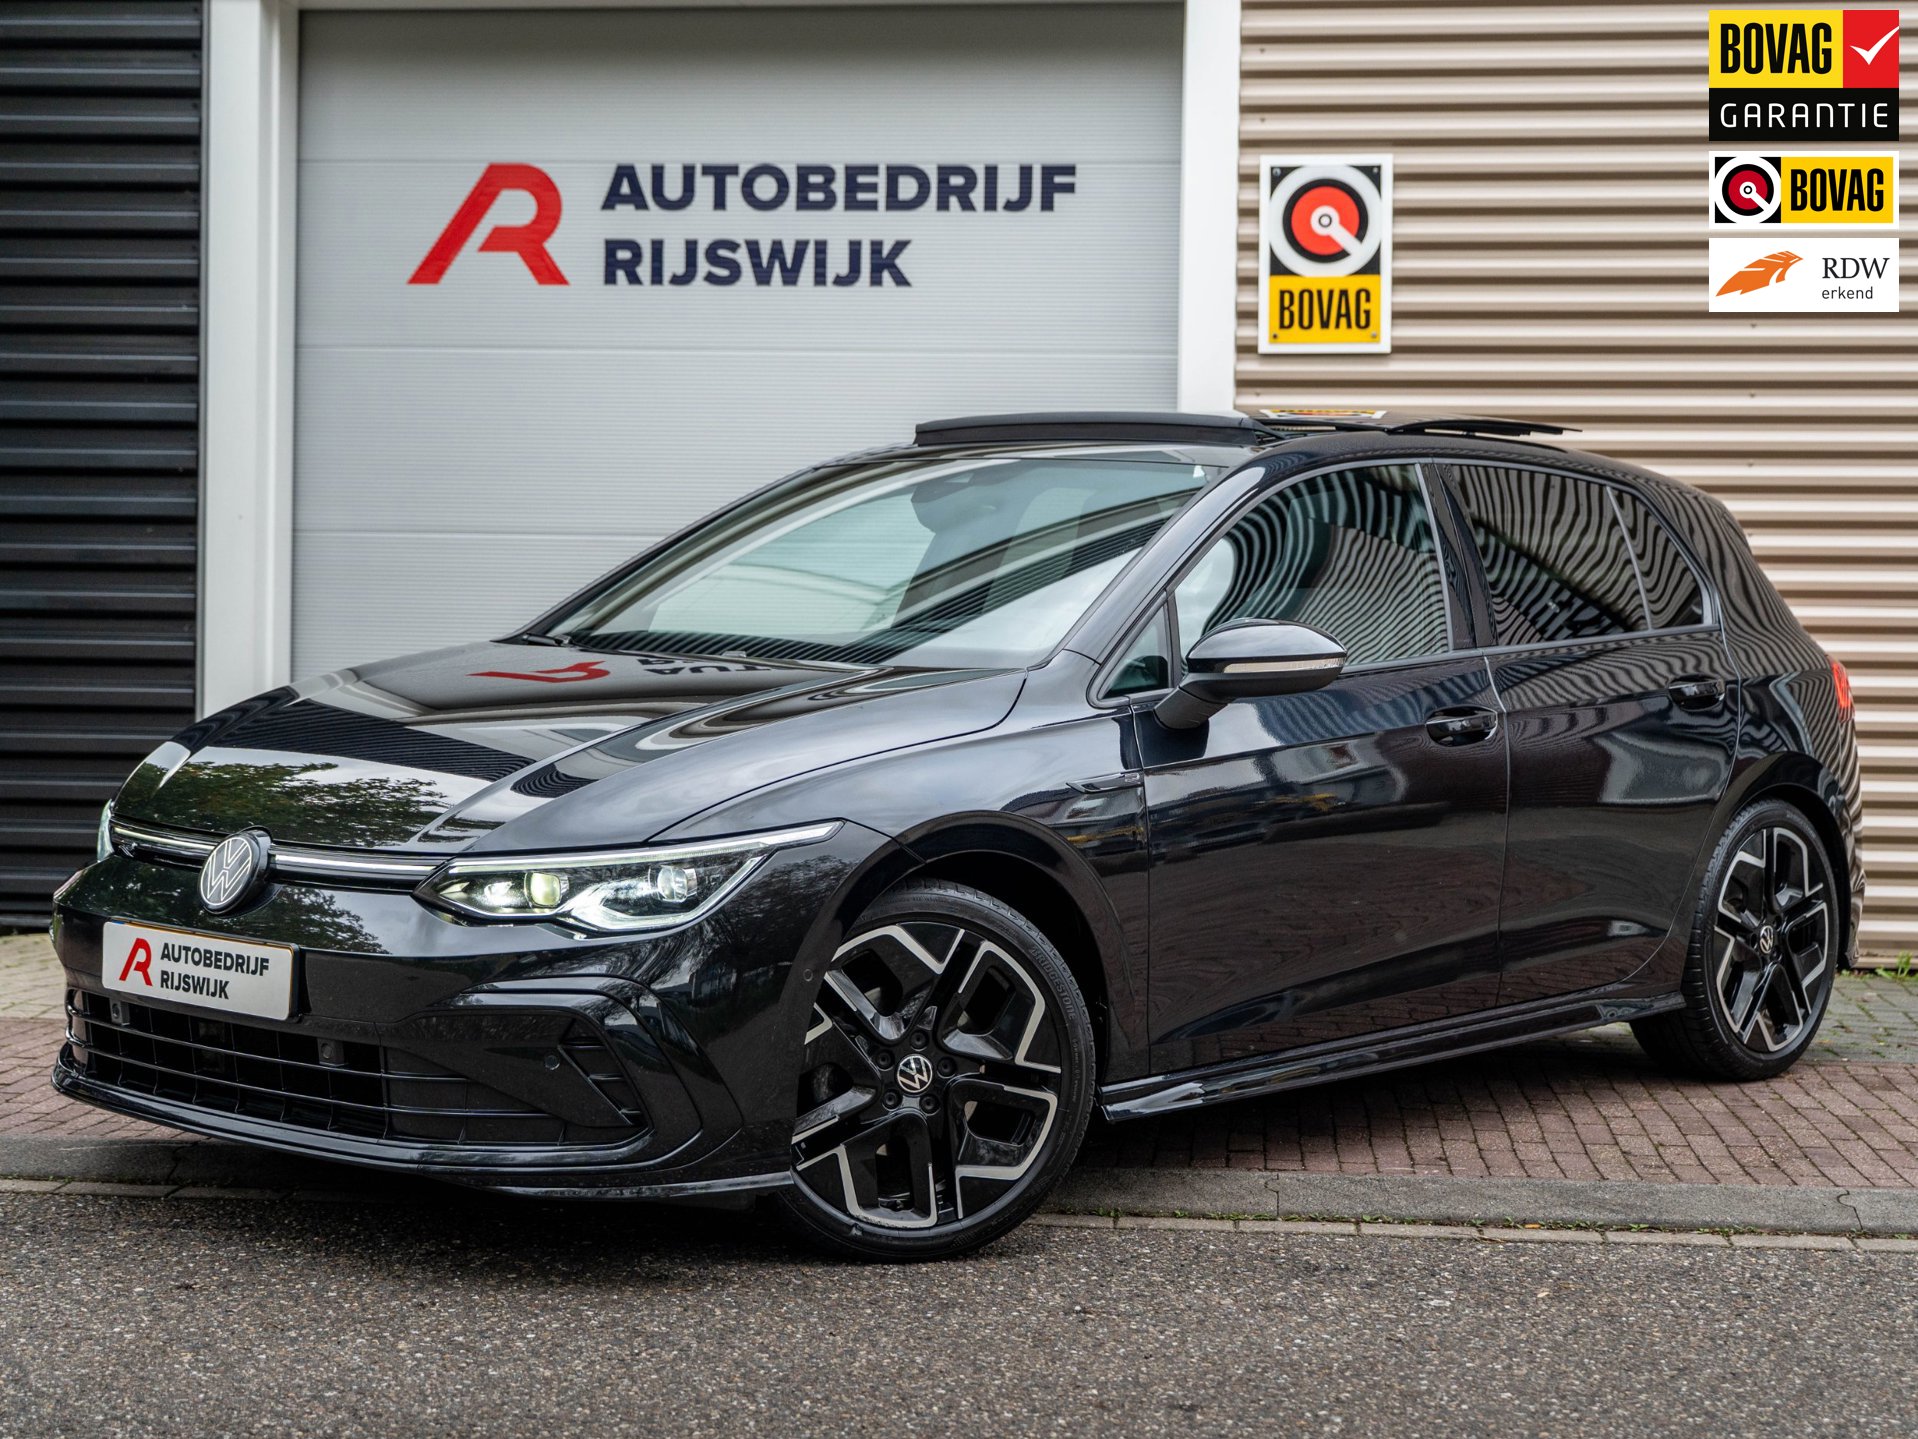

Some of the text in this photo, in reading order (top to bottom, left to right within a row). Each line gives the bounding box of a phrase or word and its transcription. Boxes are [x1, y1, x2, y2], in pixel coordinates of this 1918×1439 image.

[600, 163, 1077, 213] AUTOBEDRIJF
[603, 238, 912, 287] RIJSWIJK
[1278, 288, 1371, 330] BOVAG
[160, 942, 270, 977] AUTOBEDRIJF
[160, 970, 230, 1000] RIJSWIJK
